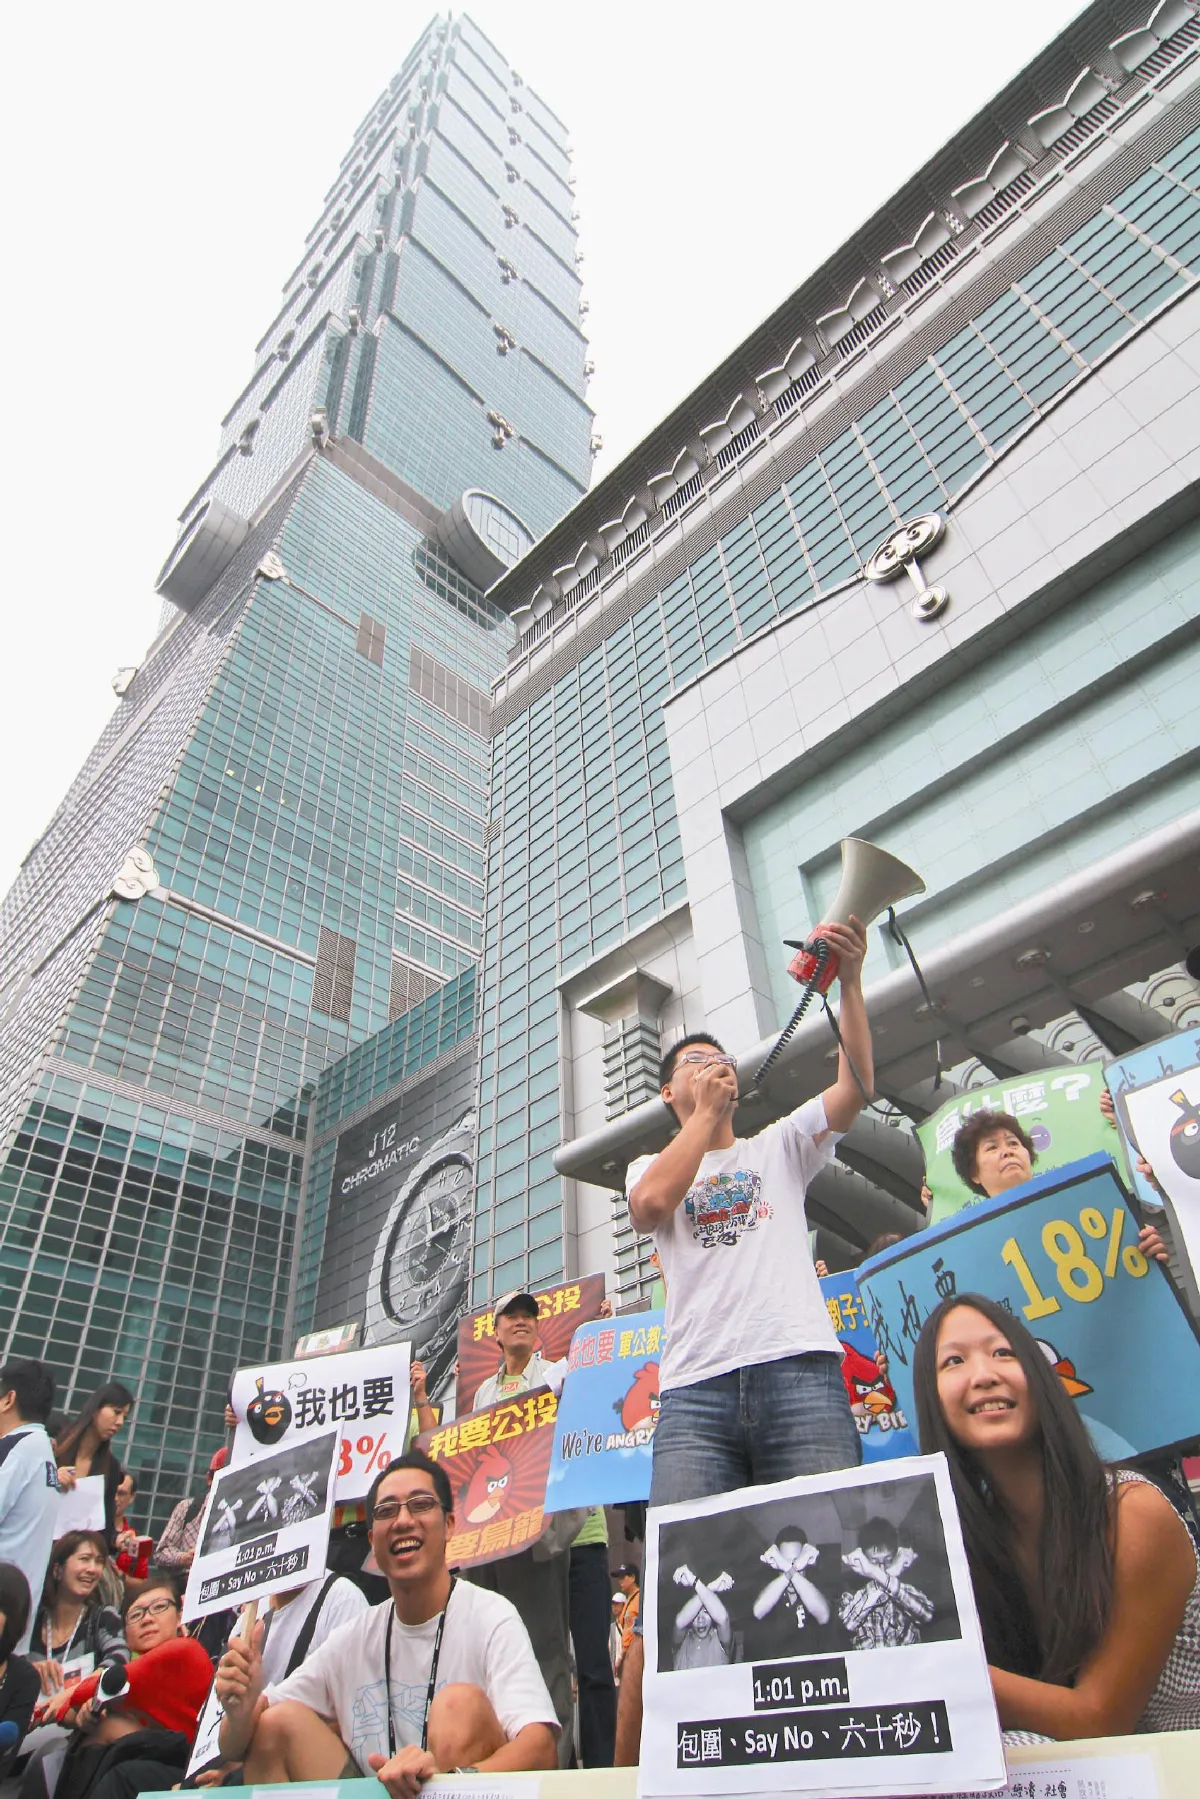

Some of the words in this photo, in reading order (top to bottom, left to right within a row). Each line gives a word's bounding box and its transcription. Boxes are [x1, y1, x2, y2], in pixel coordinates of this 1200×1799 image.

[341, 1136, 420, 1193] CHROMATIC
[1001, 1207, 1148, 1321] 18%
[473, 1285, 581, 1341] 我公投
[567, 1329, 616, 1373] 我也要
[618, 1324, 667, 1360] 單公教
[295, 1376, 394, 1429] 我也要
[428, 1392, 558, 1462] 我要公投
[562, 1428, 602, 1460] We're
[605, 1428, 656, 1451] ANGRY
[236, 1550, 254, 1564] 1:01
[256, 1542, 276, 1559] p.m.
[754, 1677, 795, 1703] 1:01
[801, 1674, 848, 1703] p.m.
[839, 1711, 940, 1751] 六十秒！
